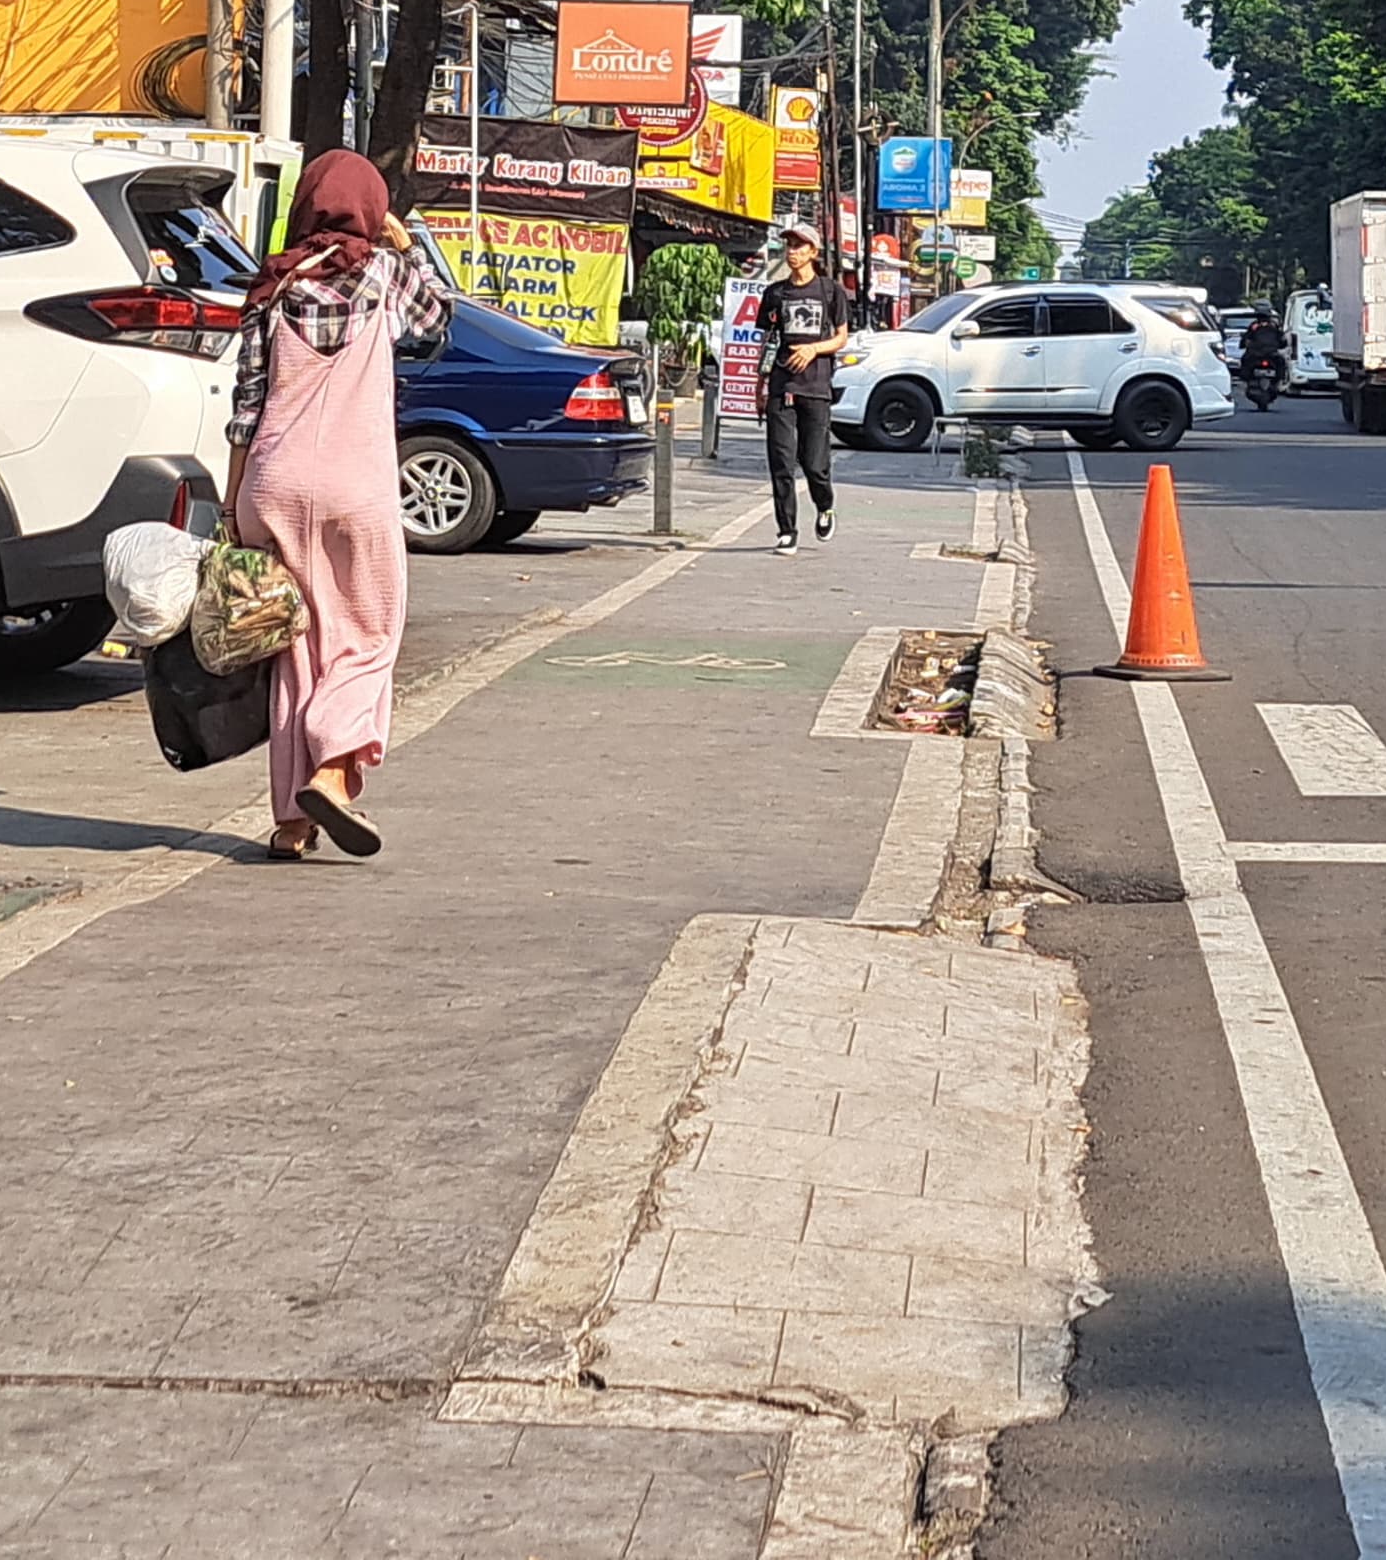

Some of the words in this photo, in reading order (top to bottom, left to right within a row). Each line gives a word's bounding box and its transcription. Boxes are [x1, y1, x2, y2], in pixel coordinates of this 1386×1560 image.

[571, 47, 673, 73] Londré
[567, 159, 632, 187] Kiloan
[515, 224, 549, 248] AC
[537, 301, 597, 321] LOCK
